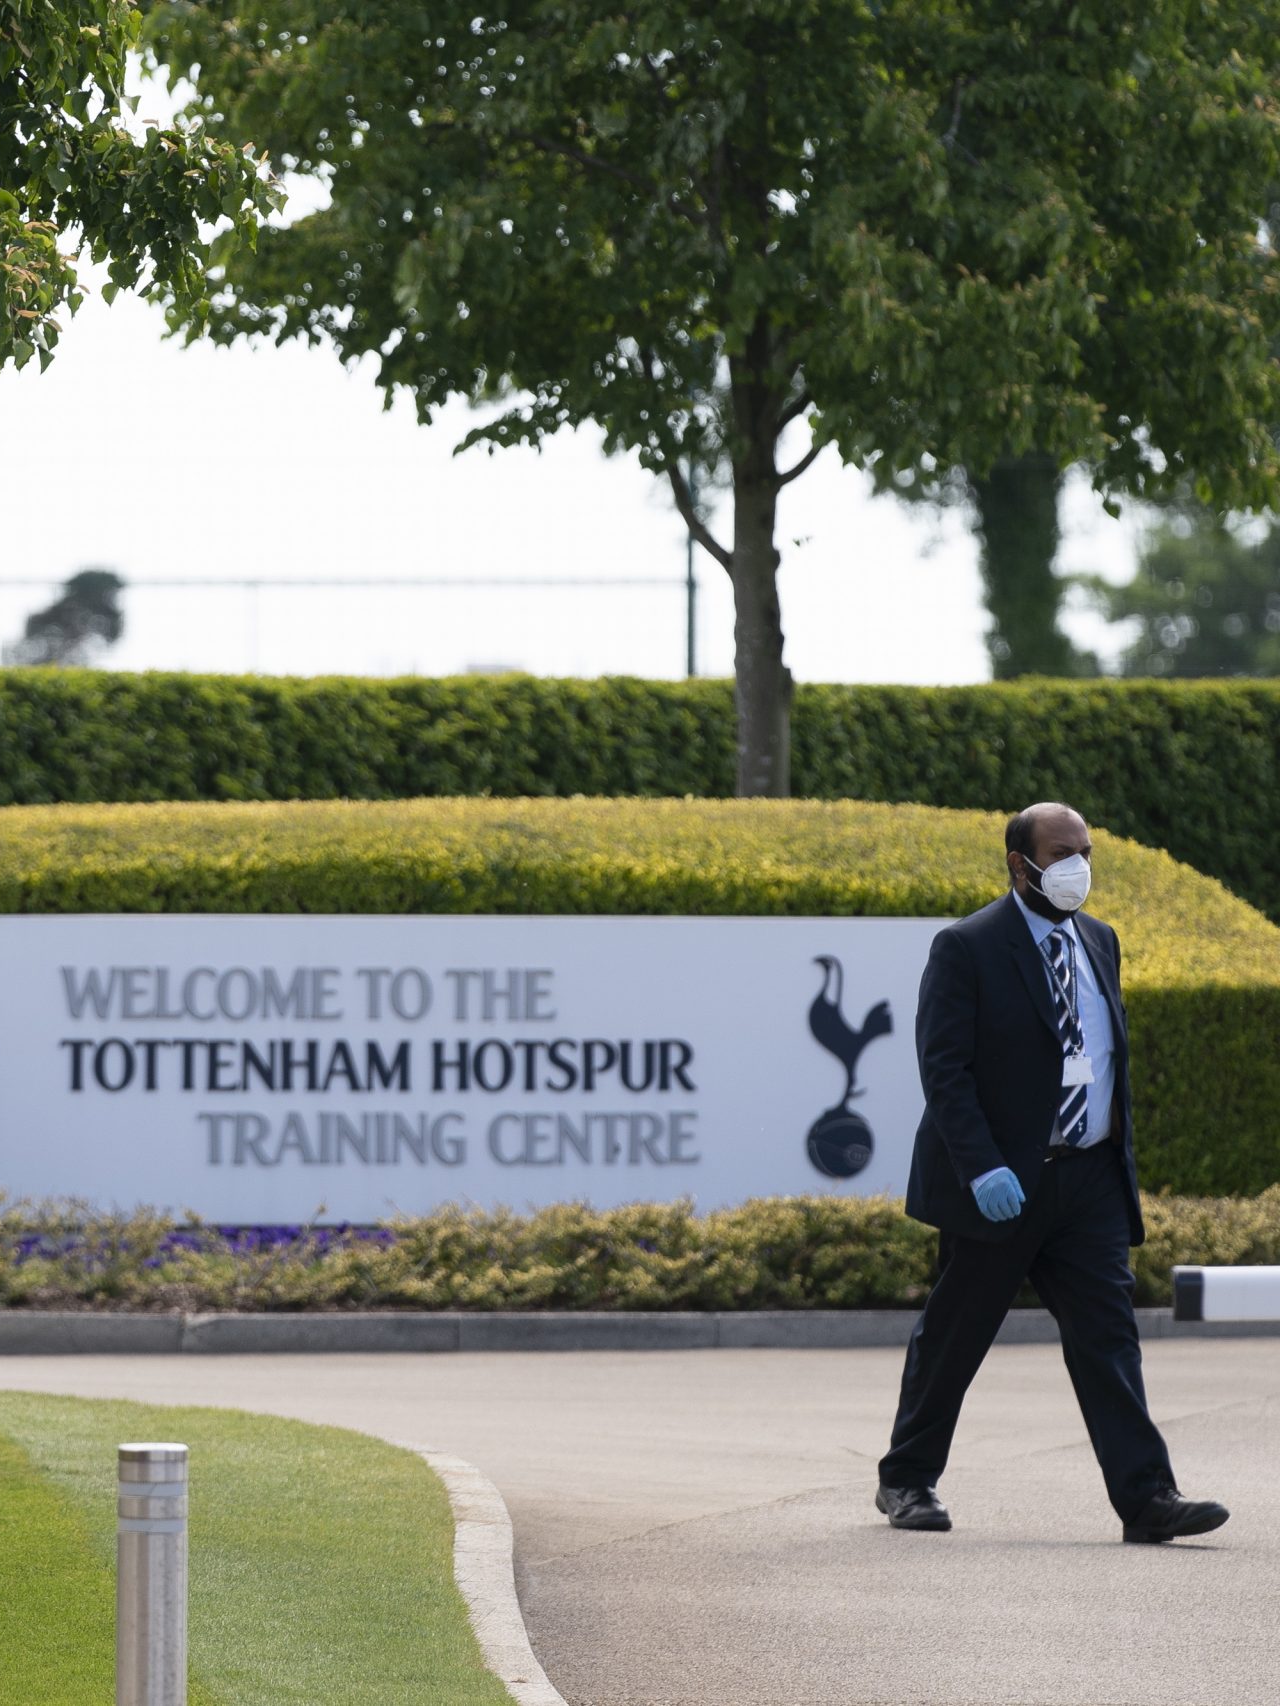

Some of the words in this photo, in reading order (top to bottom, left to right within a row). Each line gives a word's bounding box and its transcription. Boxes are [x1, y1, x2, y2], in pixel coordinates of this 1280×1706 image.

[60, 966, 342, 1023] WELCOME
[356, 966, 432, 1023] TO
[445, 968, 556, 1022] THE
[58, 1038, 412, 1093] TOTTENHAM
[430, 1037, 697, 1094] HOTSPUR
[196, 1112, 467, 1168] TRAINING
[486, 1111, 700, 1168] CENTRE
